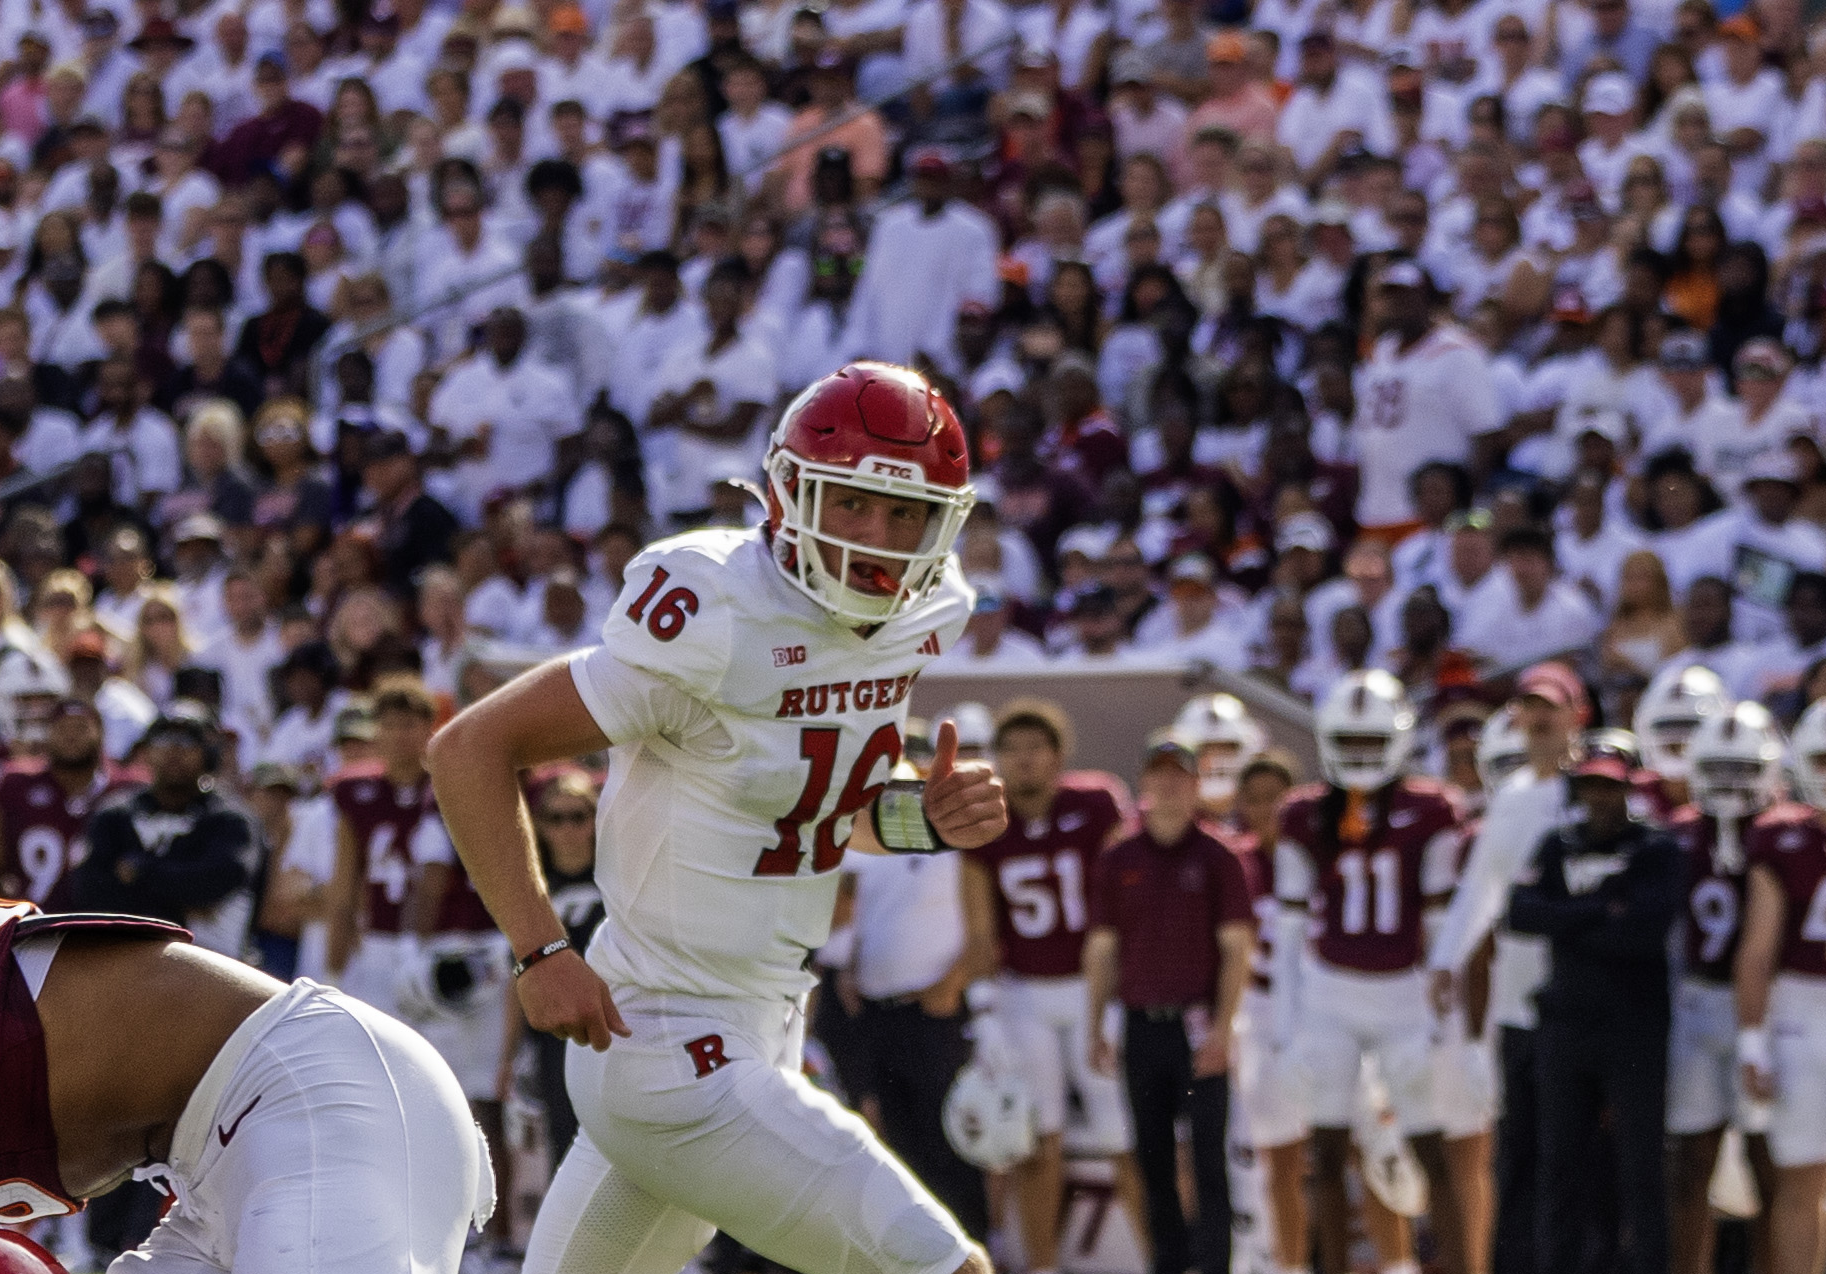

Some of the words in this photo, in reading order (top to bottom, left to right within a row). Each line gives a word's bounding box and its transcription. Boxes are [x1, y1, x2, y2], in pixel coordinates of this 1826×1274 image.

[625, 565, 699, 643] 16
[775, 670, 921, 718] RUTGER
[752, 721, 903, 877] 16
[998, 850, 1088, 940] 51
[1335, 848, 1404, 936] 11
[683, 1033, 731, 1080] R
